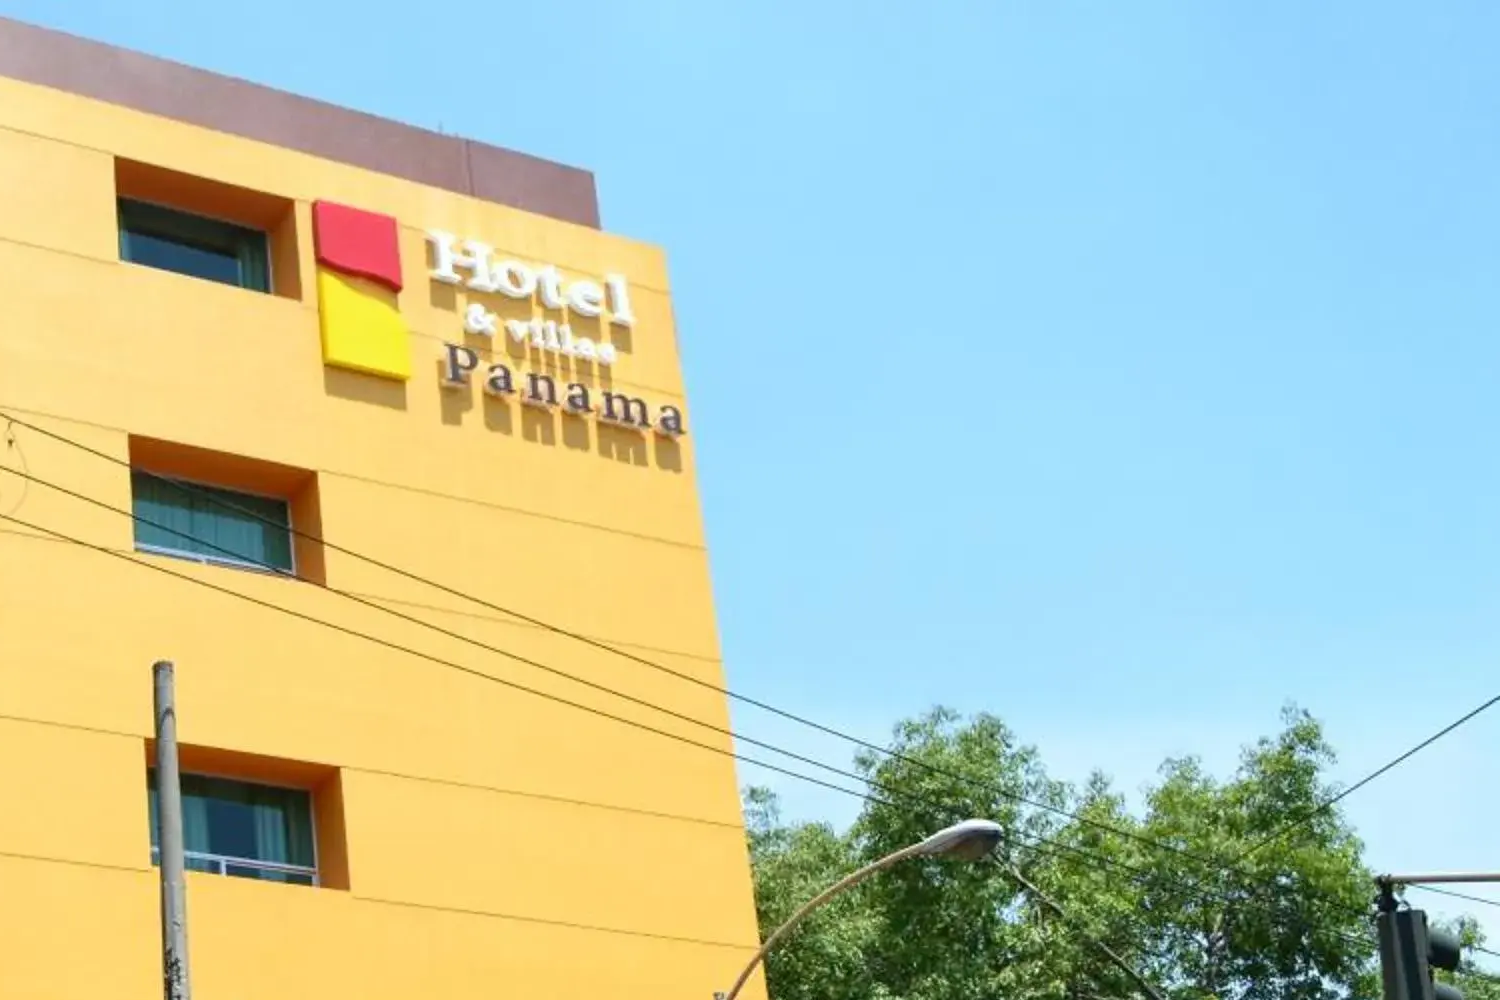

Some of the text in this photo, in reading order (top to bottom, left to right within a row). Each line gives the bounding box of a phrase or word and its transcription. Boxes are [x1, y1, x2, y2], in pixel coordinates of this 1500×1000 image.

[428, 228, 636, 325] Hotel
[464, 302, 496, 336] &
[443, 342, 685, 437] Panama
